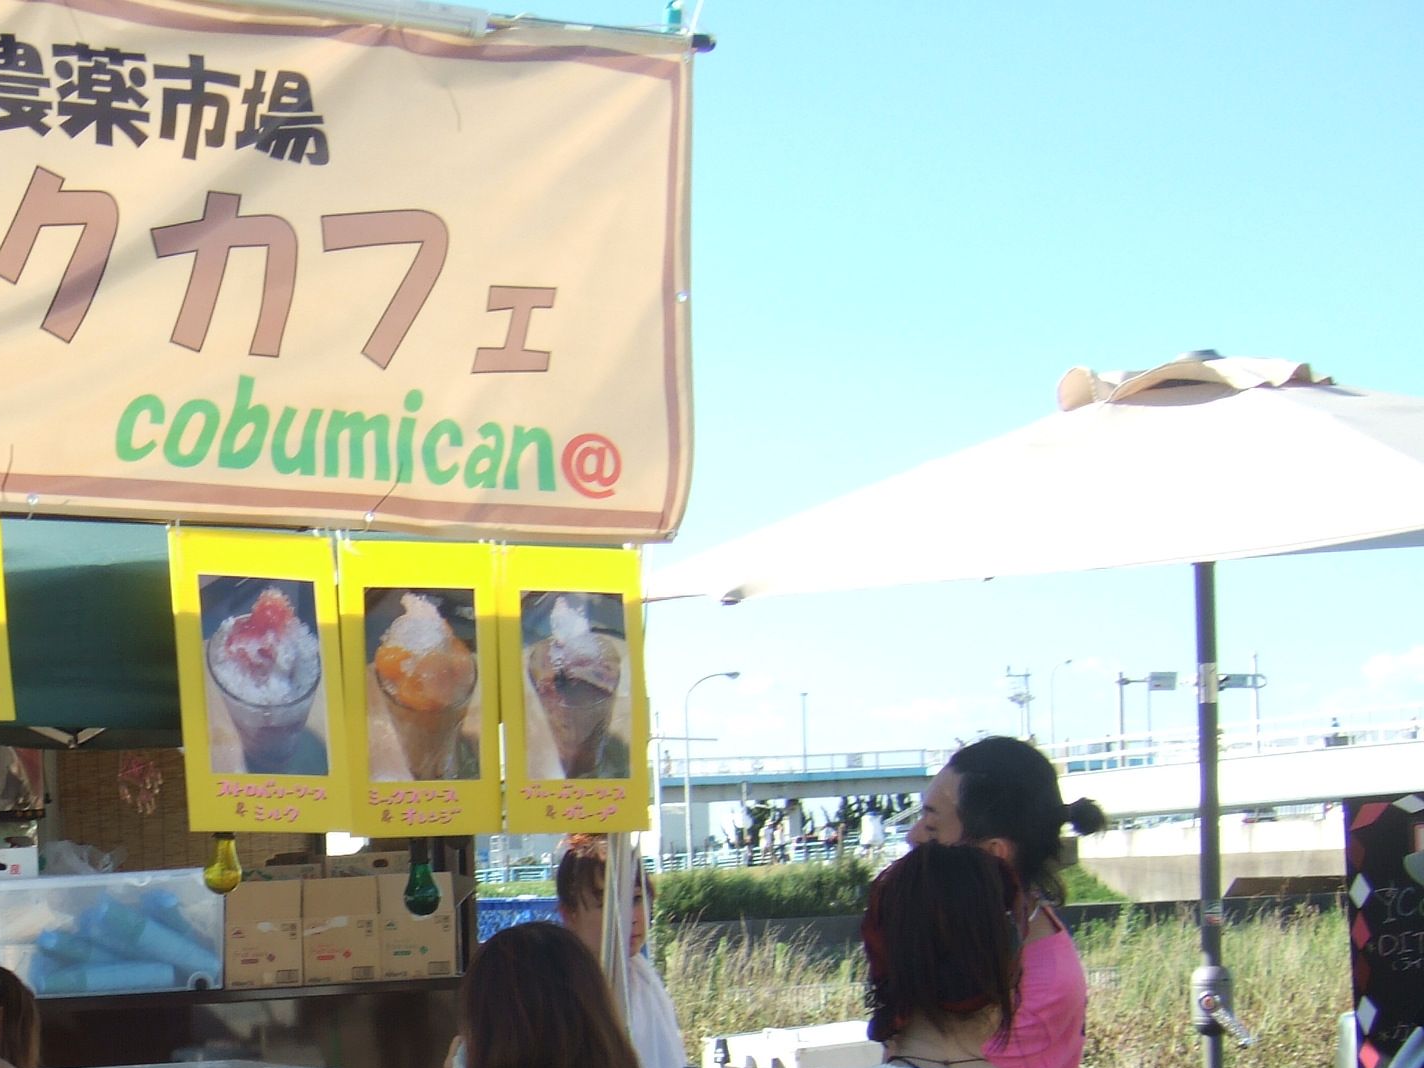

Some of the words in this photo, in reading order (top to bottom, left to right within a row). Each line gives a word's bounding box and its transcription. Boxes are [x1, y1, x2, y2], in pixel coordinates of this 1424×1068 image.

[255, 805, 300, 822] ミルク
[402, 808, 461, 826] オレンジ
